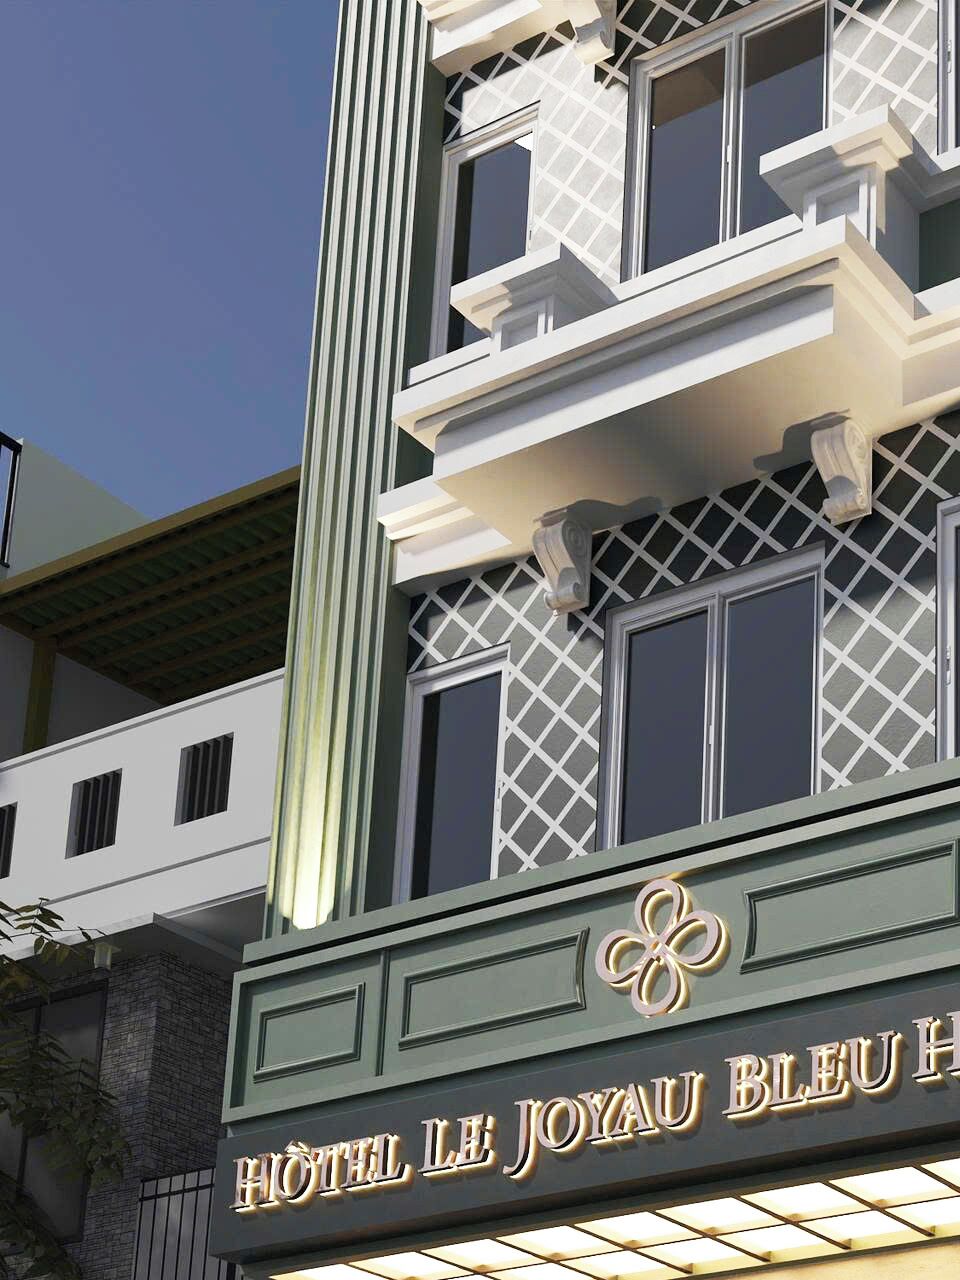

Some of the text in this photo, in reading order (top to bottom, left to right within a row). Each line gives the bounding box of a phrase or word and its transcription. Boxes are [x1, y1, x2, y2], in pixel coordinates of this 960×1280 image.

[229, 1132, 410, 1213] HÔTEL
[418, 1113, 496, 1175] LE
[502, 1070, 704, 1180] JOYAU
[722, 1029, 902, 1119] BLEU
